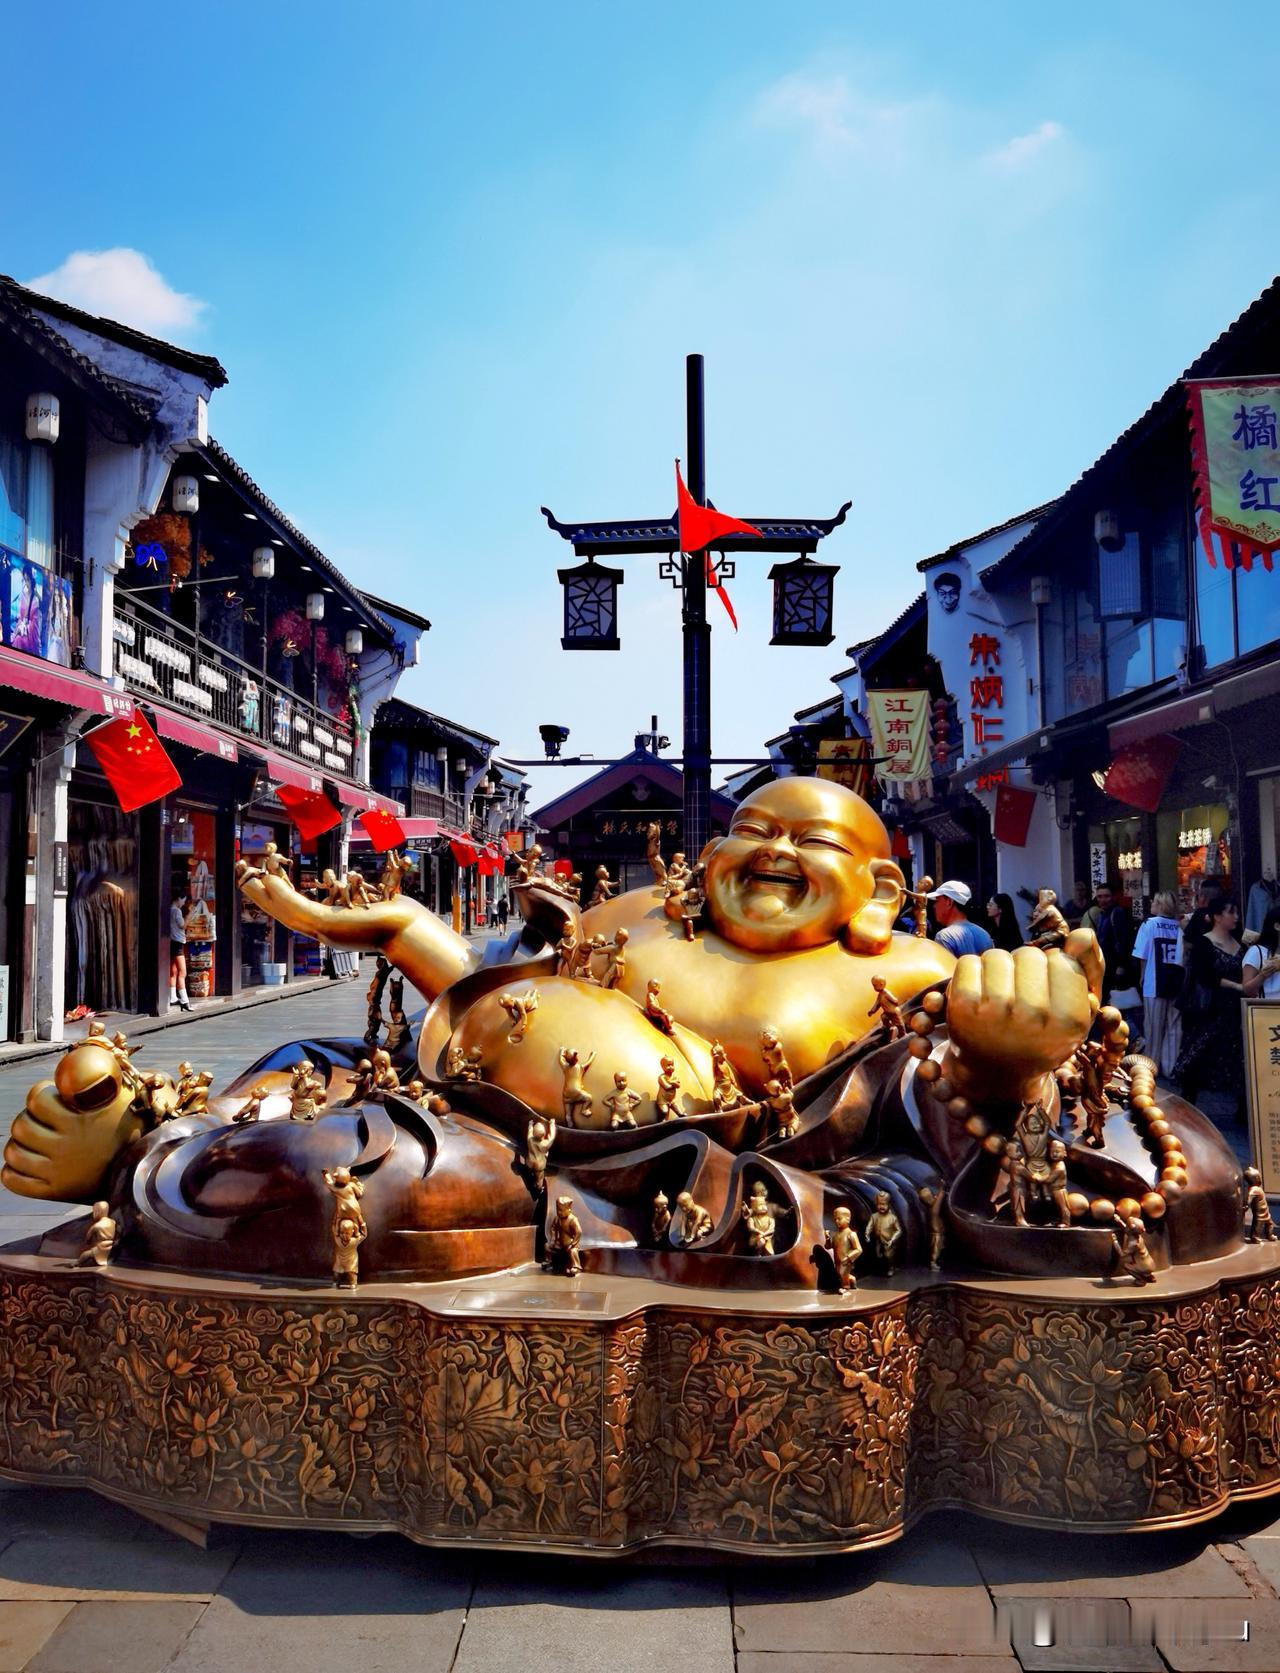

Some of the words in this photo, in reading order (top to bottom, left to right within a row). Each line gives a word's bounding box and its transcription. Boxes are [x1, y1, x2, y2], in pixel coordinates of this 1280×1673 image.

[1233, 404, 1280, 512] 橘红
[884, 698, 914, 774] 江南銅屋
[969, 633, 1003, 745] 朱炳仁
